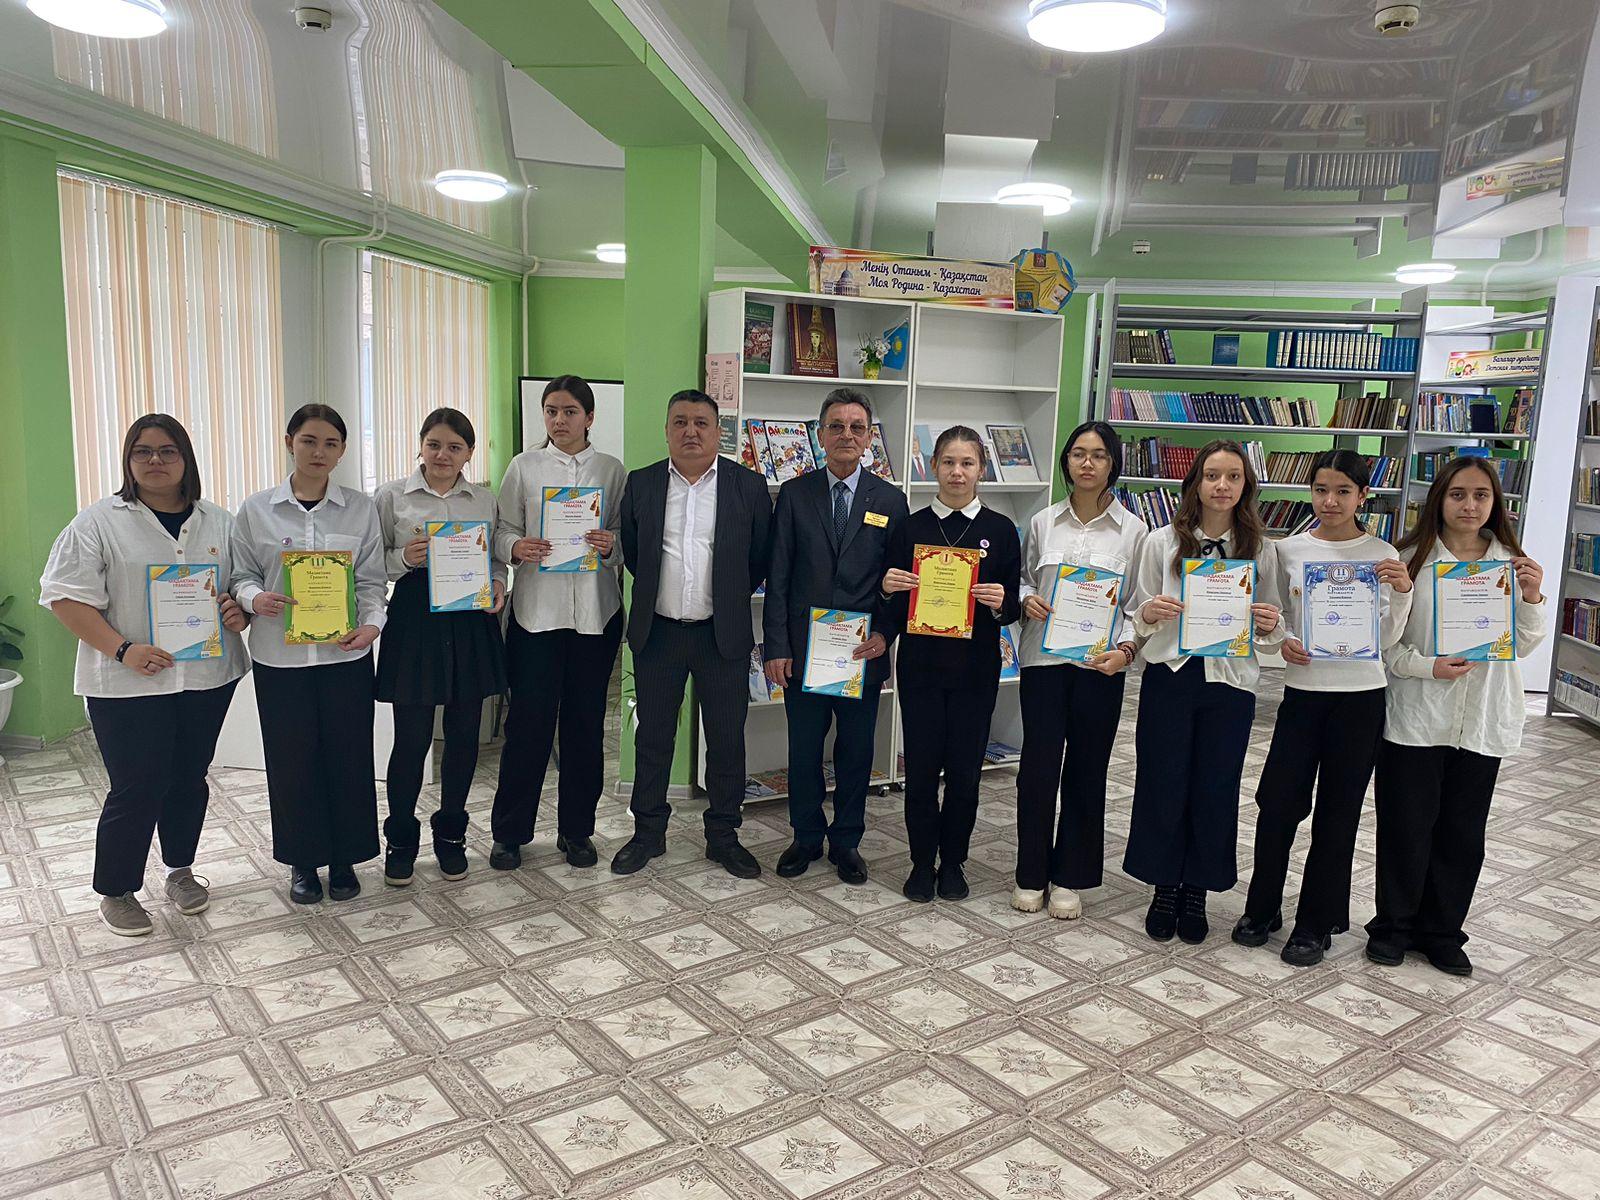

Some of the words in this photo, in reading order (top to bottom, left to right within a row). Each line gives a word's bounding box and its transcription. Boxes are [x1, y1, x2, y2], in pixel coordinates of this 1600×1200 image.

[860, 260, 889, 276] Менің
[892, 263, 931, 278] Отаным
[939, 267, 988, 282] Қазақстан
[868, 276, 889, 288] Моя
[891, 278, 924, 294] Родина
[932, 281, 981, 297] Казахстан
[311, 558, 325, 566] III
